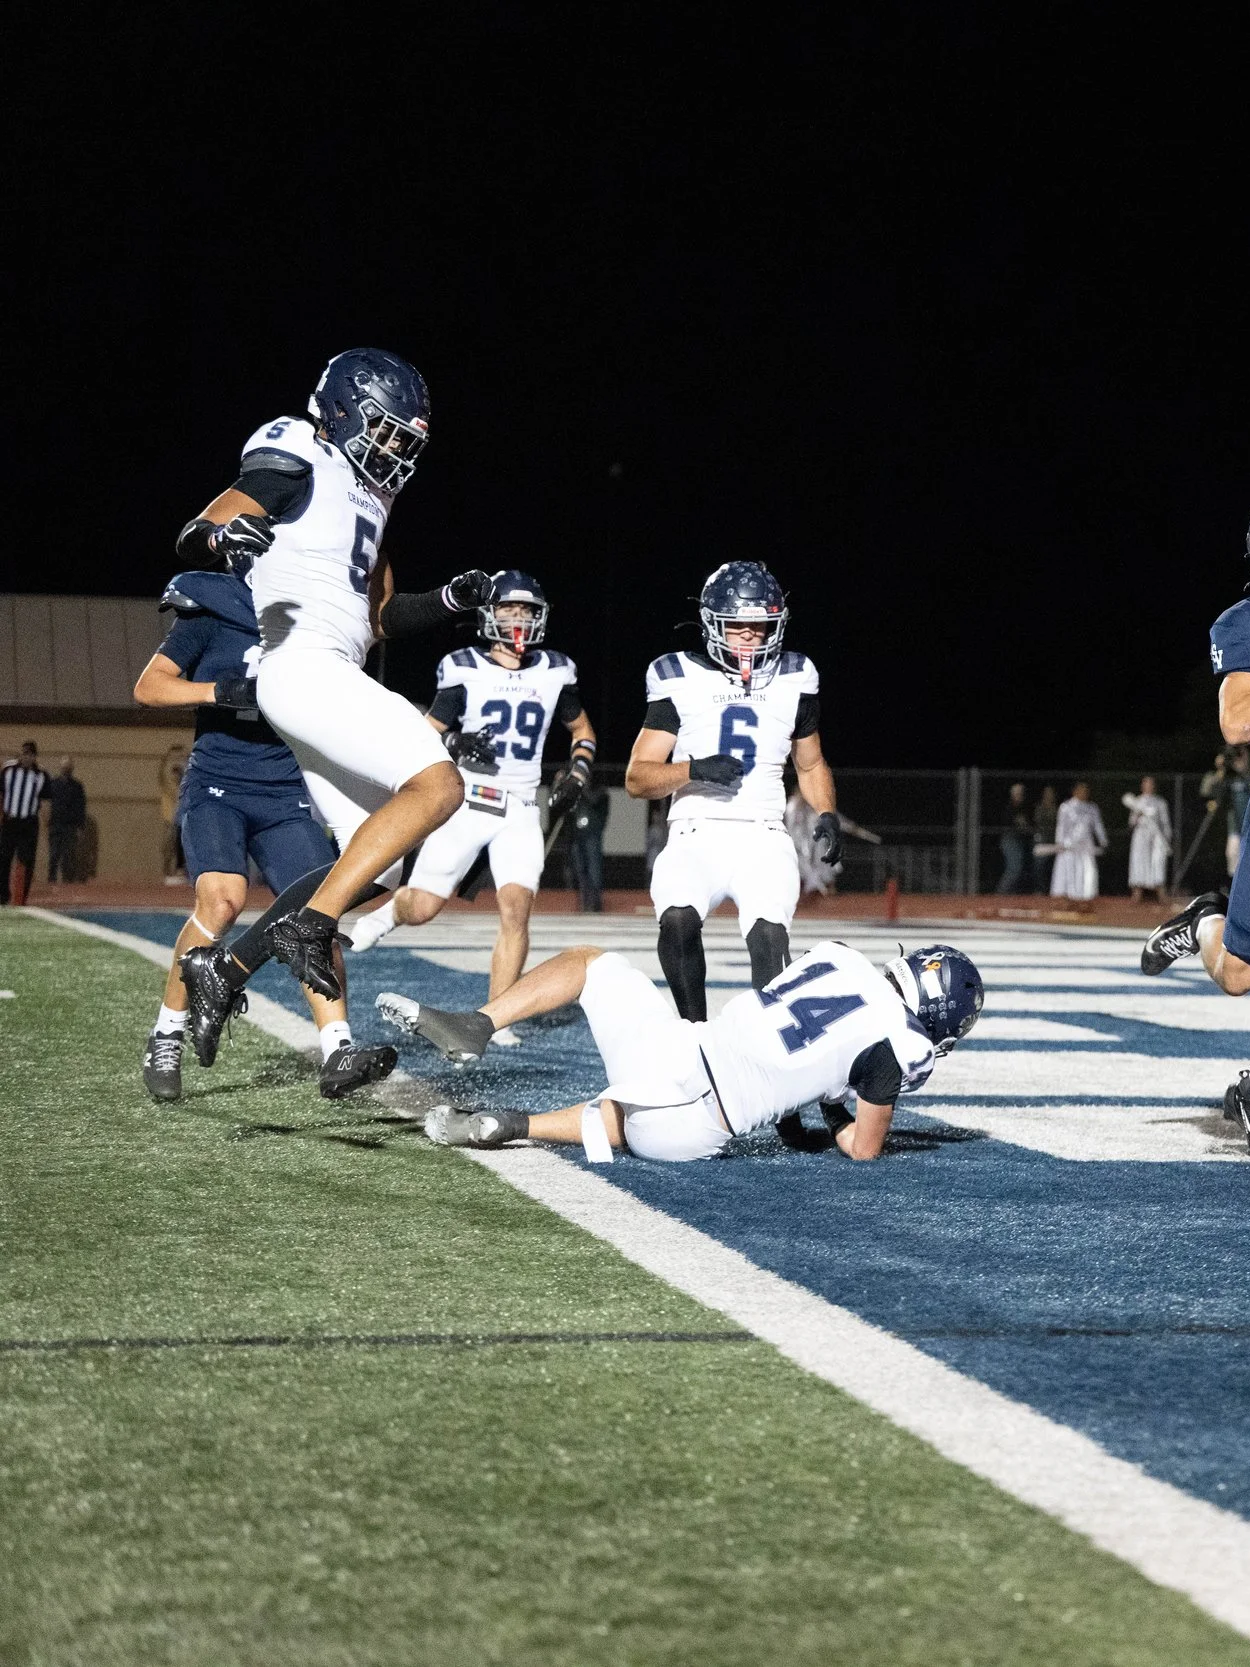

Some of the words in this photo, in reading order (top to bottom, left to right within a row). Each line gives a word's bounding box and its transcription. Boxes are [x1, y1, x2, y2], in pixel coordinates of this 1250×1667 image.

[266, 421, 292, 440] 5
[349, 511, 378, 597] 5
[481, 699, 546, 761] 29
[718, 704, 759, 777] 6
[753, 961, 869, 1055] 14
